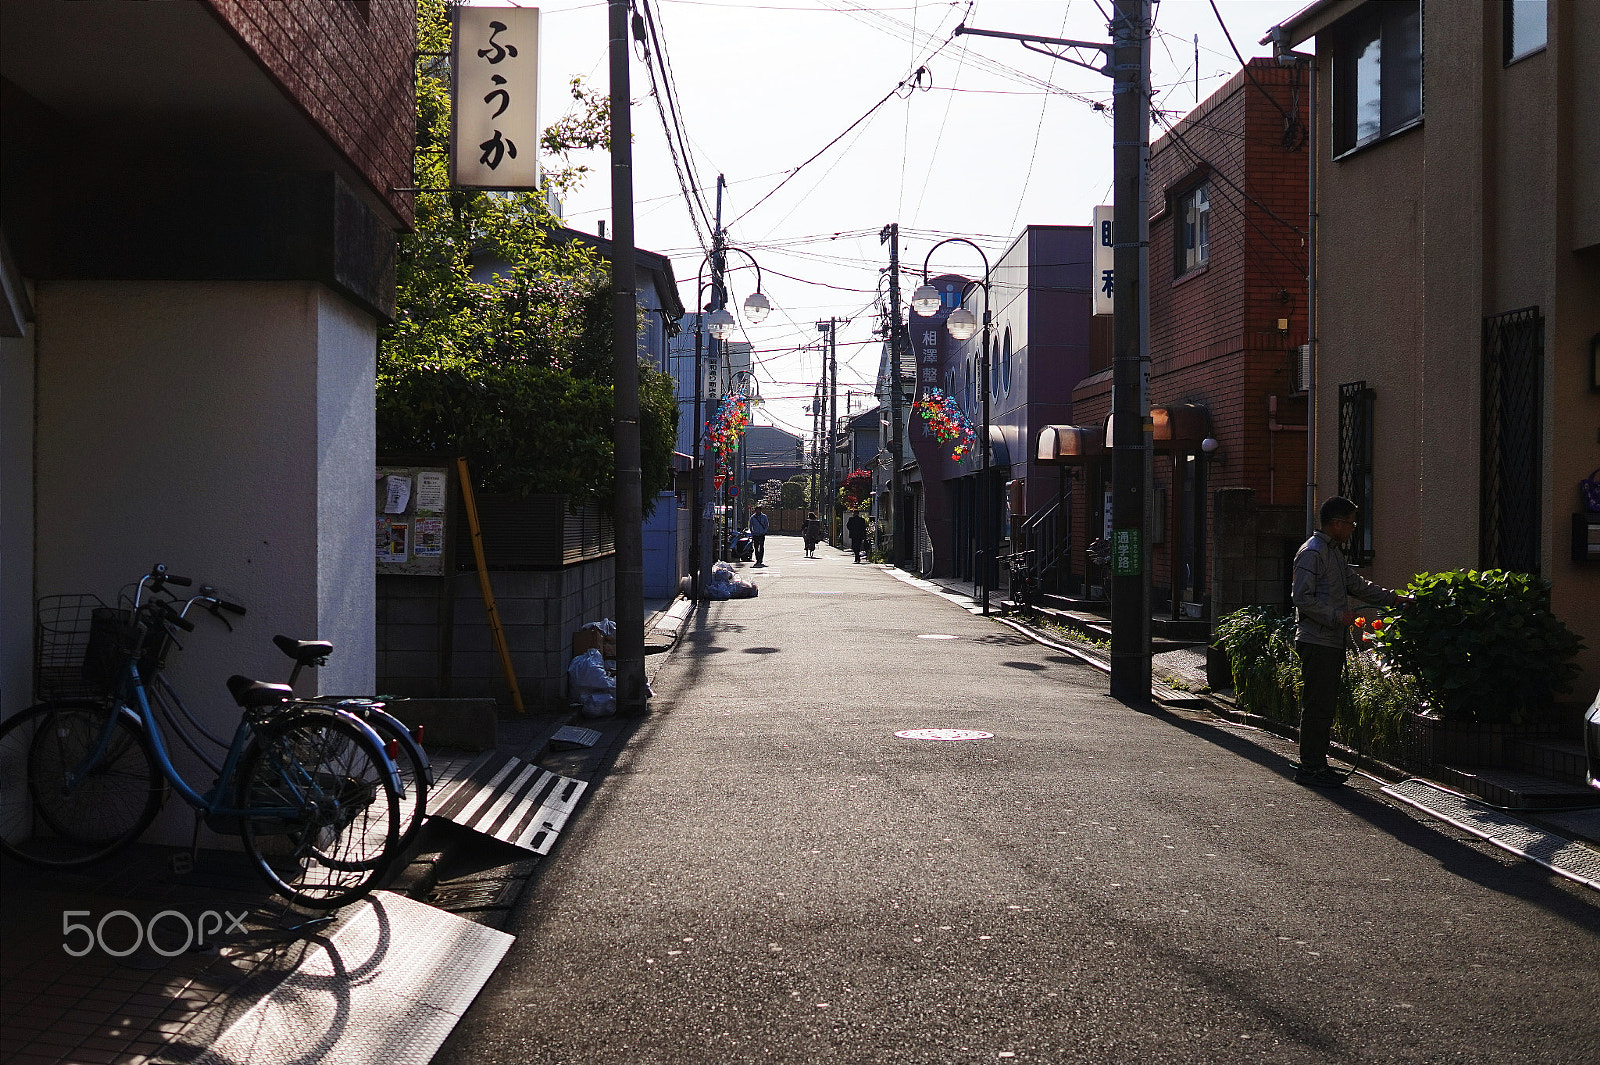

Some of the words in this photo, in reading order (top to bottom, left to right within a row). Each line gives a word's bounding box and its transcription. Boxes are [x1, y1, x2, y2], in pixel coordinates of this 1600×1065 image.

[477, 20, 518, 171] ふうか
[922, 330, 938, 438] 相澤整科
[1117, 531, 1129, 569] 通学路
